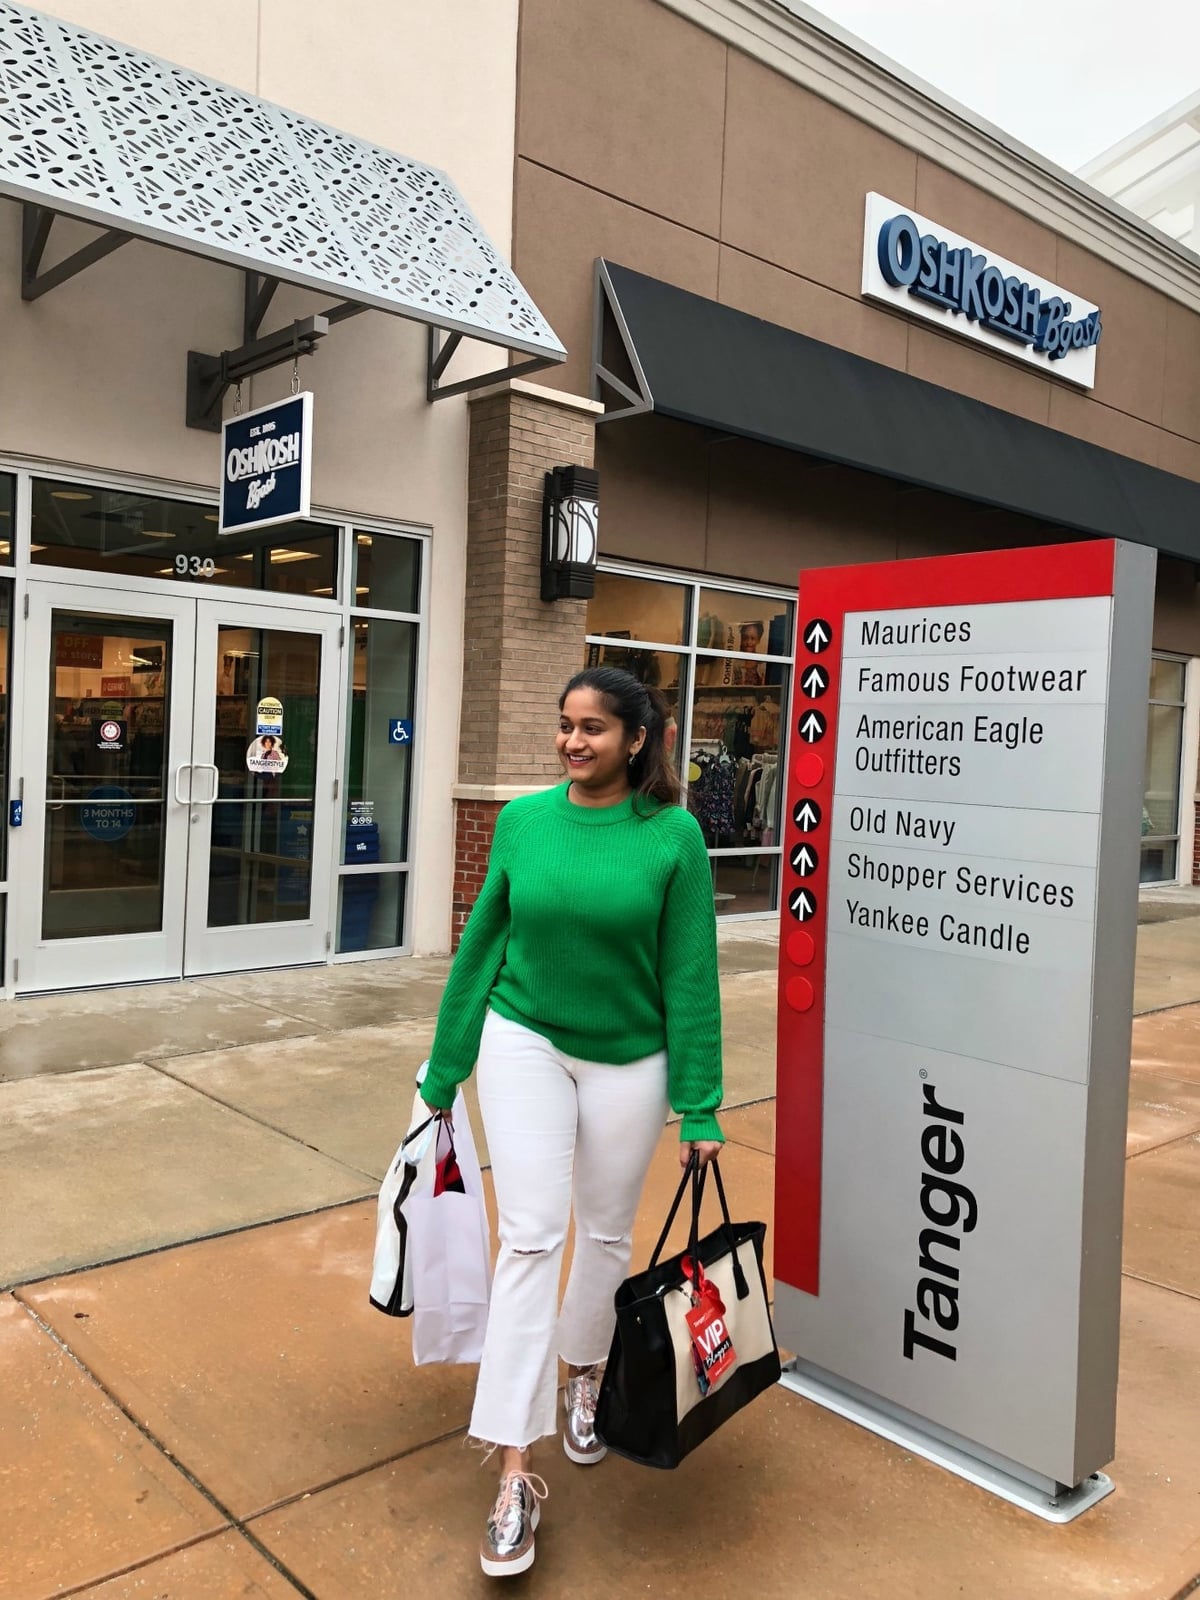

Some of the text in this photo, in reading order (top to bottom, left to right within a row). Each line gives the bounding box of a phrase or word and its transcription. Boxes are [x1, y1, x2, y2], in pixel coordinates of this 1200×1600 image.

[878, 214, 1042, 345] OSHKOSH
[227, 432, 300, 482] OSHKOSH
[175, 554, 215, 578] 930
[861, 617, 971, 646] Maurices
[858, 665, 1087, 693] Famous Footwear
[258, 707, 282, 715] CAUTION
[855, 714, 1043, 750] American Eagle
[249, 759, 285, 768] TANGERSTYLE
[855, 746, 961, 777] Outfitters
[83, 808, 134, 818] 3 MONTHS
[95, 819, 110, 829] TO
[850, 806, 956, 847] Old Navy
[847, 853, 1074, 908] Shopper Services
[846, 898, 1030, 954] Yankee Candle
[903, 1083, 978, 1362] Tanger
[697, 1318, 725, 1354] VIP
